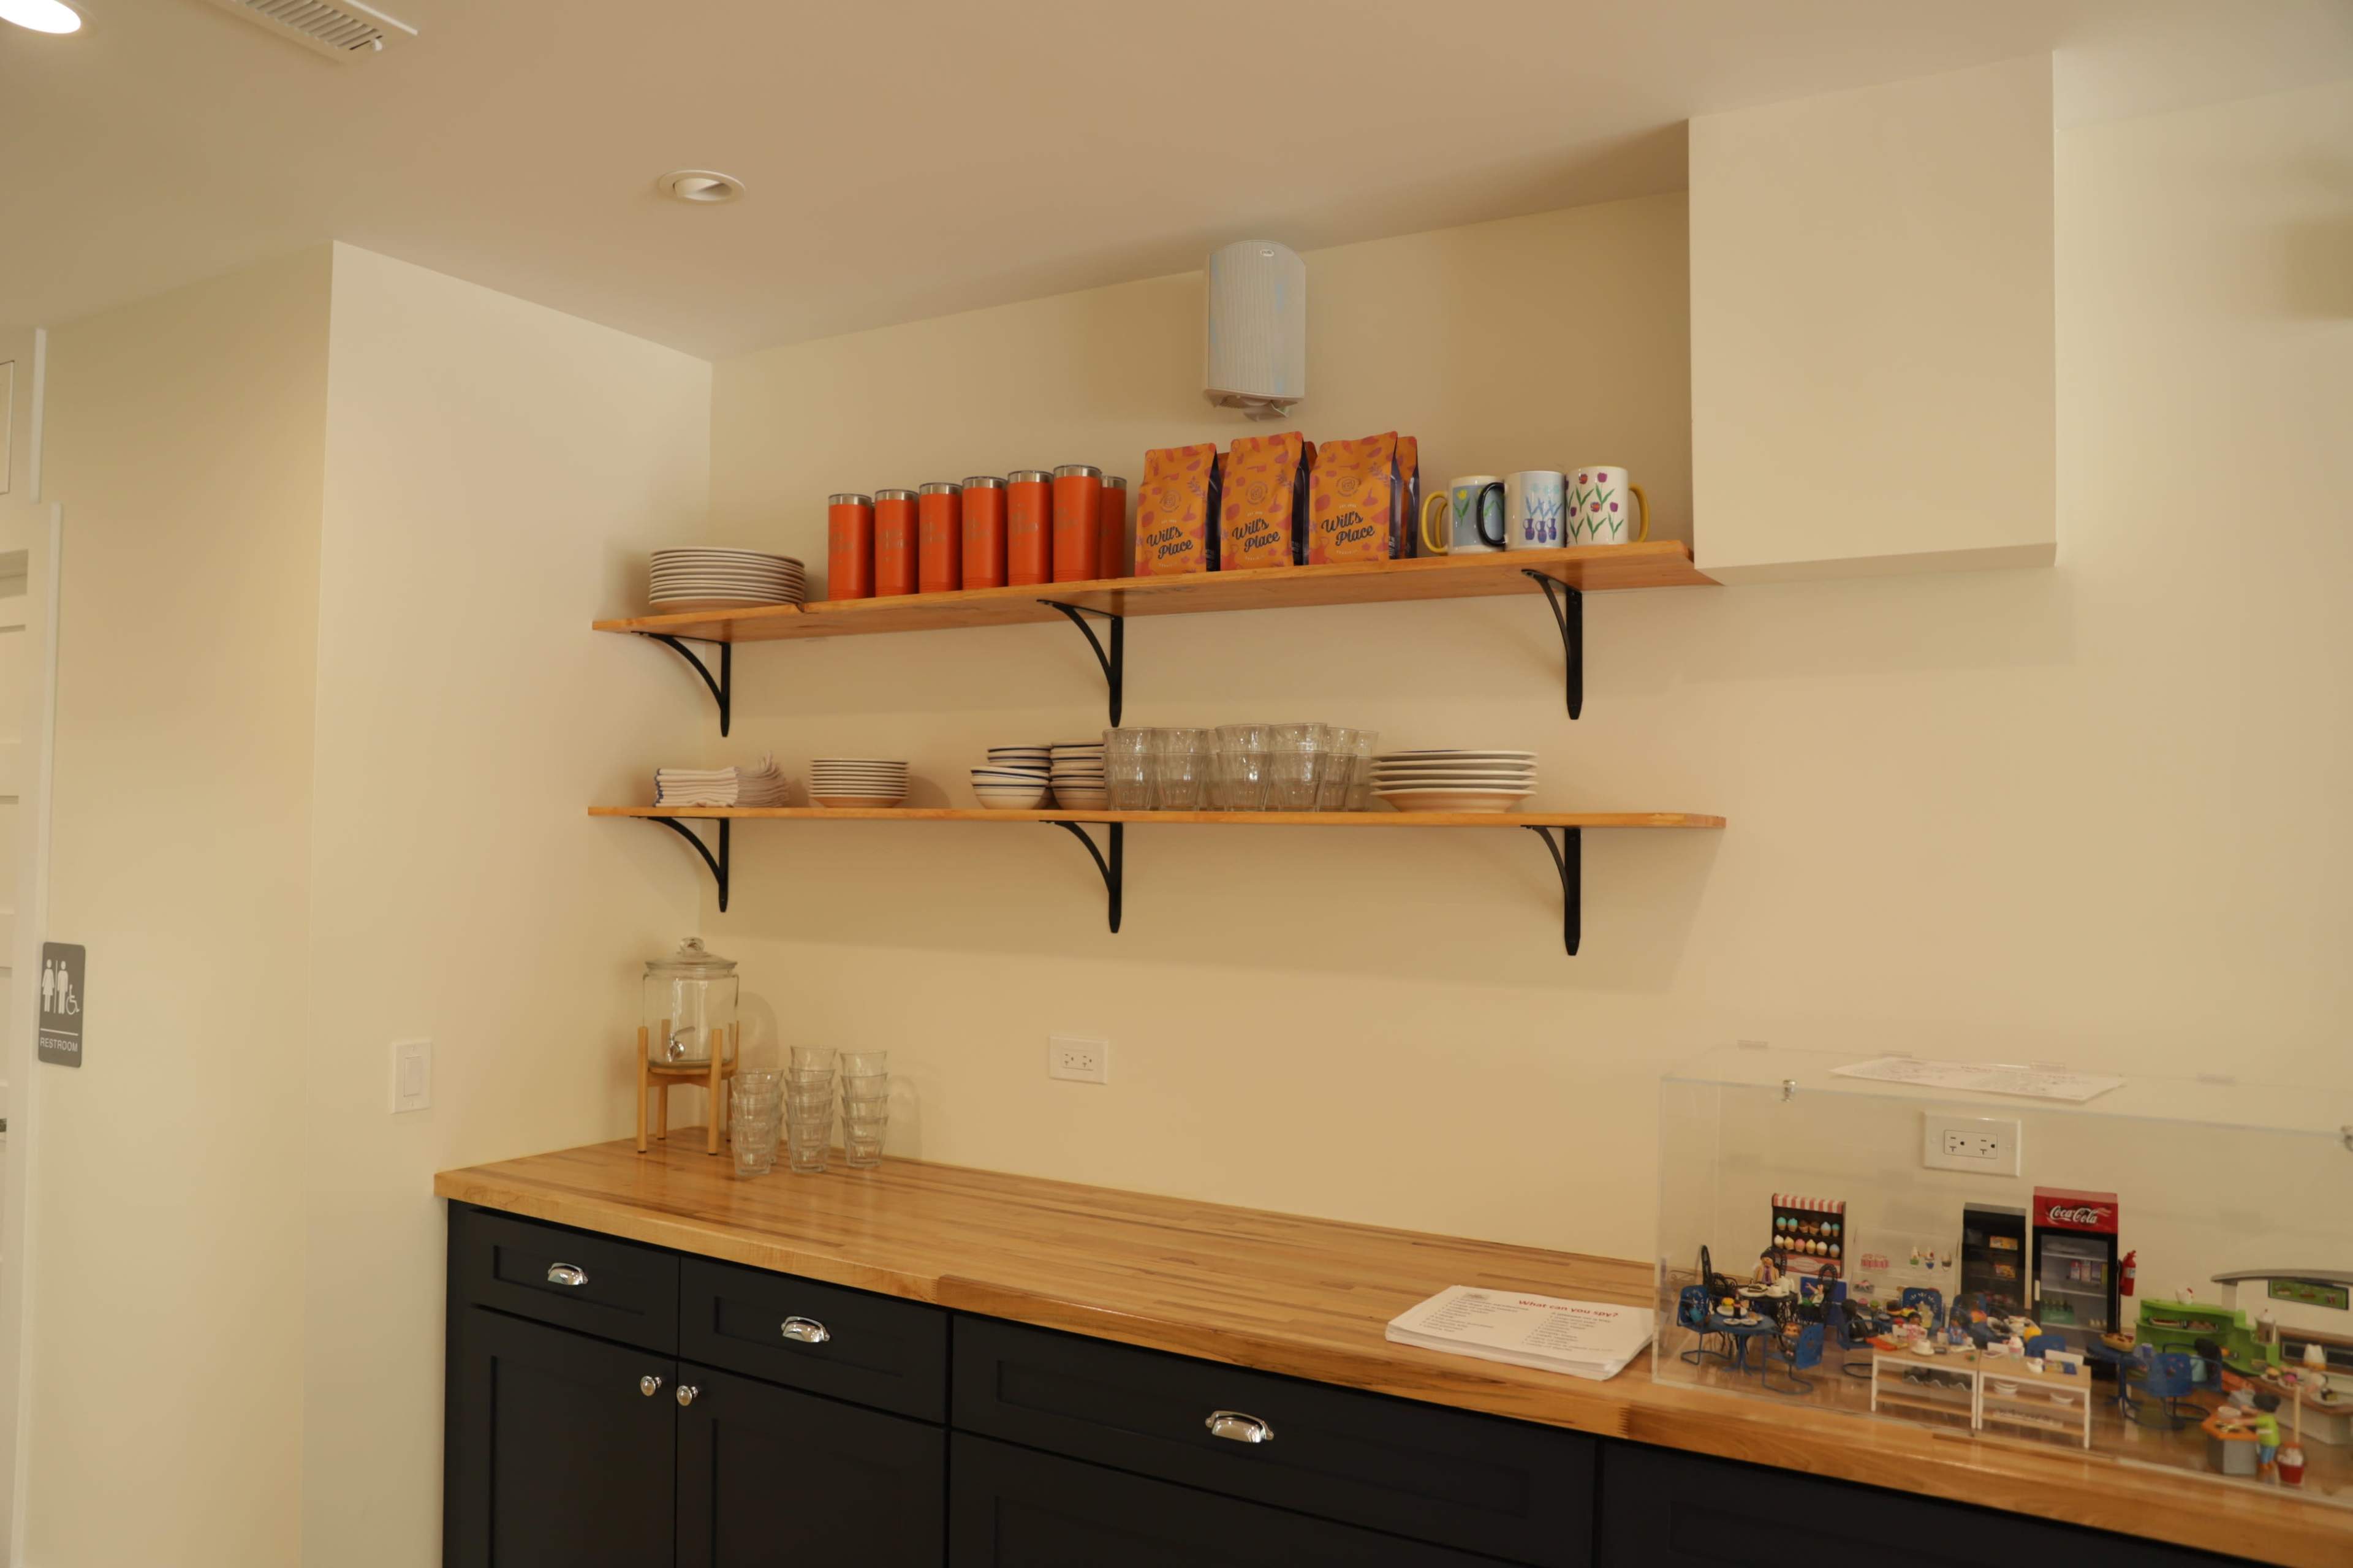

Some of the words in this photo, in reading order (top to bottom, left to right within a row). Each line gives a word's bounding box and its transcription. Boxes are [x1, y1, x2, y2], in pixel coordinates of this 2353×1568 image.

[1232, 518, 1269, 540] Will's
[1321, 511, 1363, 532] Will's
[1146, 526, 1183, 547] Will's
[1244, 531, 1280, 552] Place
[1335, 525, 1375, 547] Place
[1158, 539, 1193, 559] Place
[40, 1037, 78, 1052] RESTROOM
[2049, 1205, 2098, 1224] Coca-Cola
